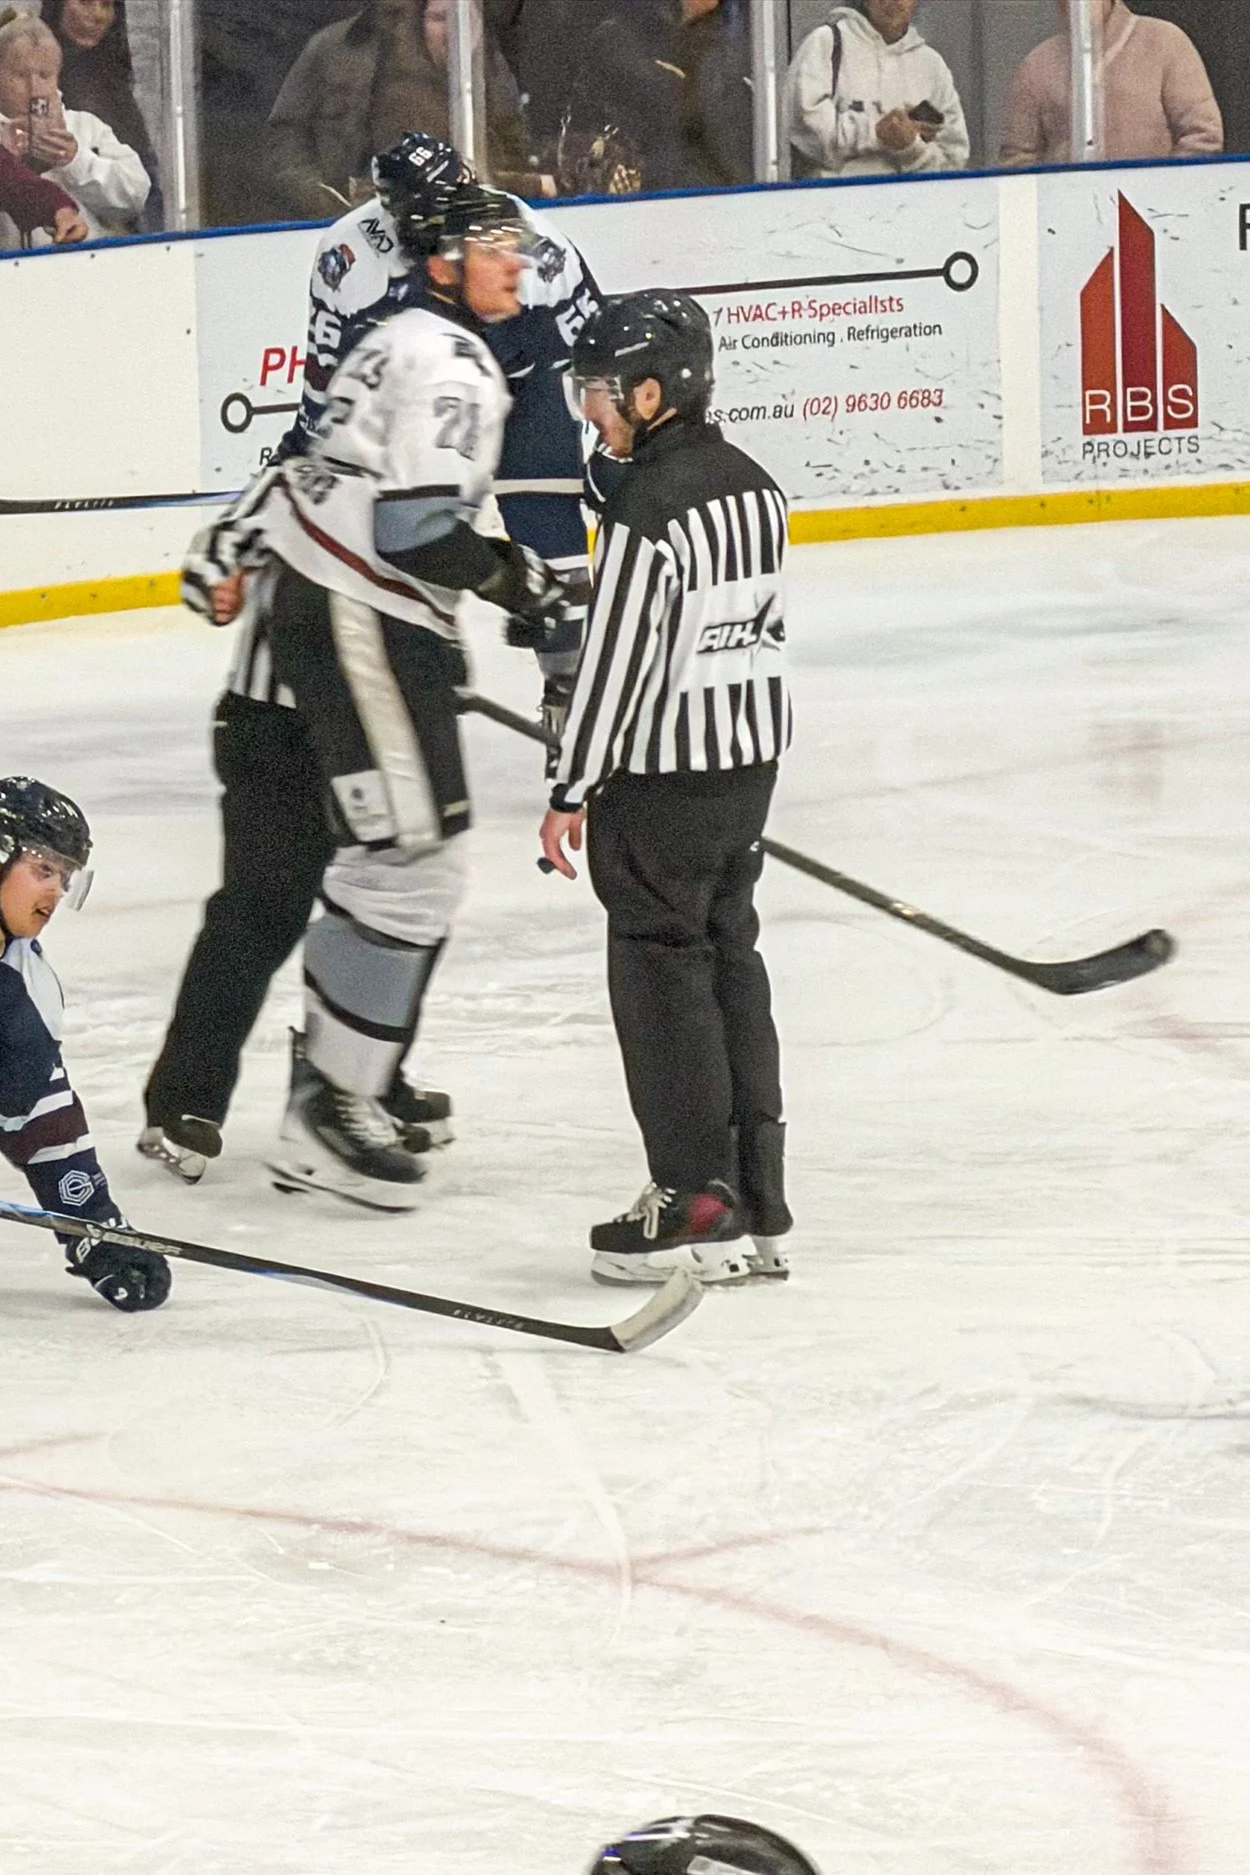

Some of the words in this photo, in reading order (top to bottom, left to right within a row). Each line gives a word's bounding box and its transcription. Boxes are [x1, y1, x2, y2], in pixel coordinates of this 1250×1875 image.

[726, 302, 803, 324] HVAC+R
[807, 295, 904, 322] Specialists
[718, 335, 739, 352] Air
[741, 329, 836, 350] Conditioning
[846, 321, 943, 344] Refrigeration
[802, 395, 839, 422] (02)
[845, 391, 892, 415] 9630
[897, 388, 945, 410] 6683
[1084, 384, 1195, 425] RBS
[1081, 436, 1201, 460] PROJECTS
